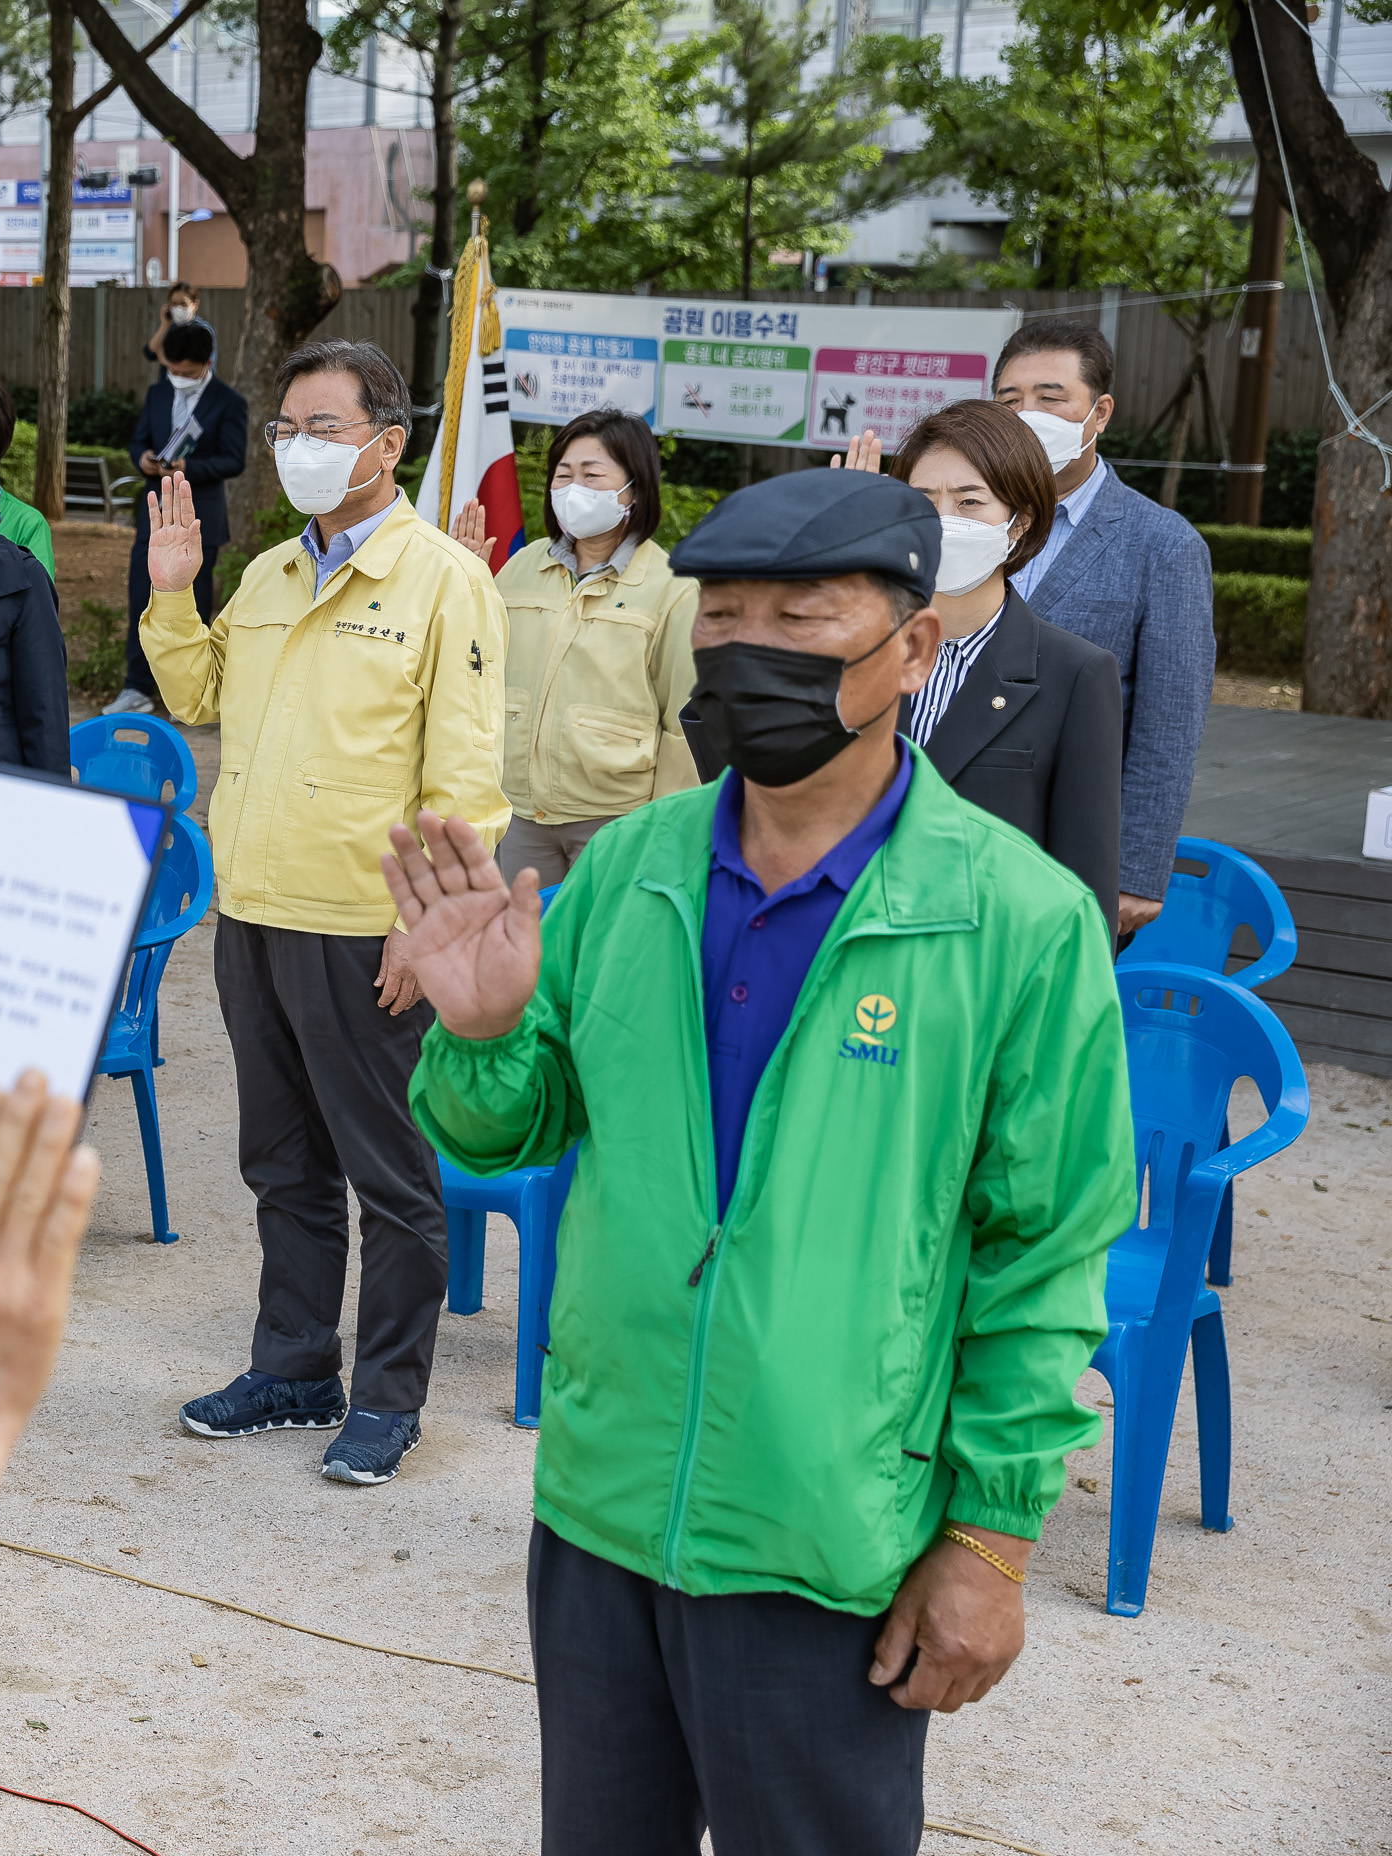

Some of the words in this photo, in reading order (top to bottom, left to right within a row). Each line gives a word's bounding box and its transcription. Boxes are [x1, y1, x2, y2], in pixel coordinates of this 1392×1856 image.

[664, 307, 704, 335] 공원
[711, 310, 799, 341] 이용수칙
[839, 1037, 900, 1067] SMU
